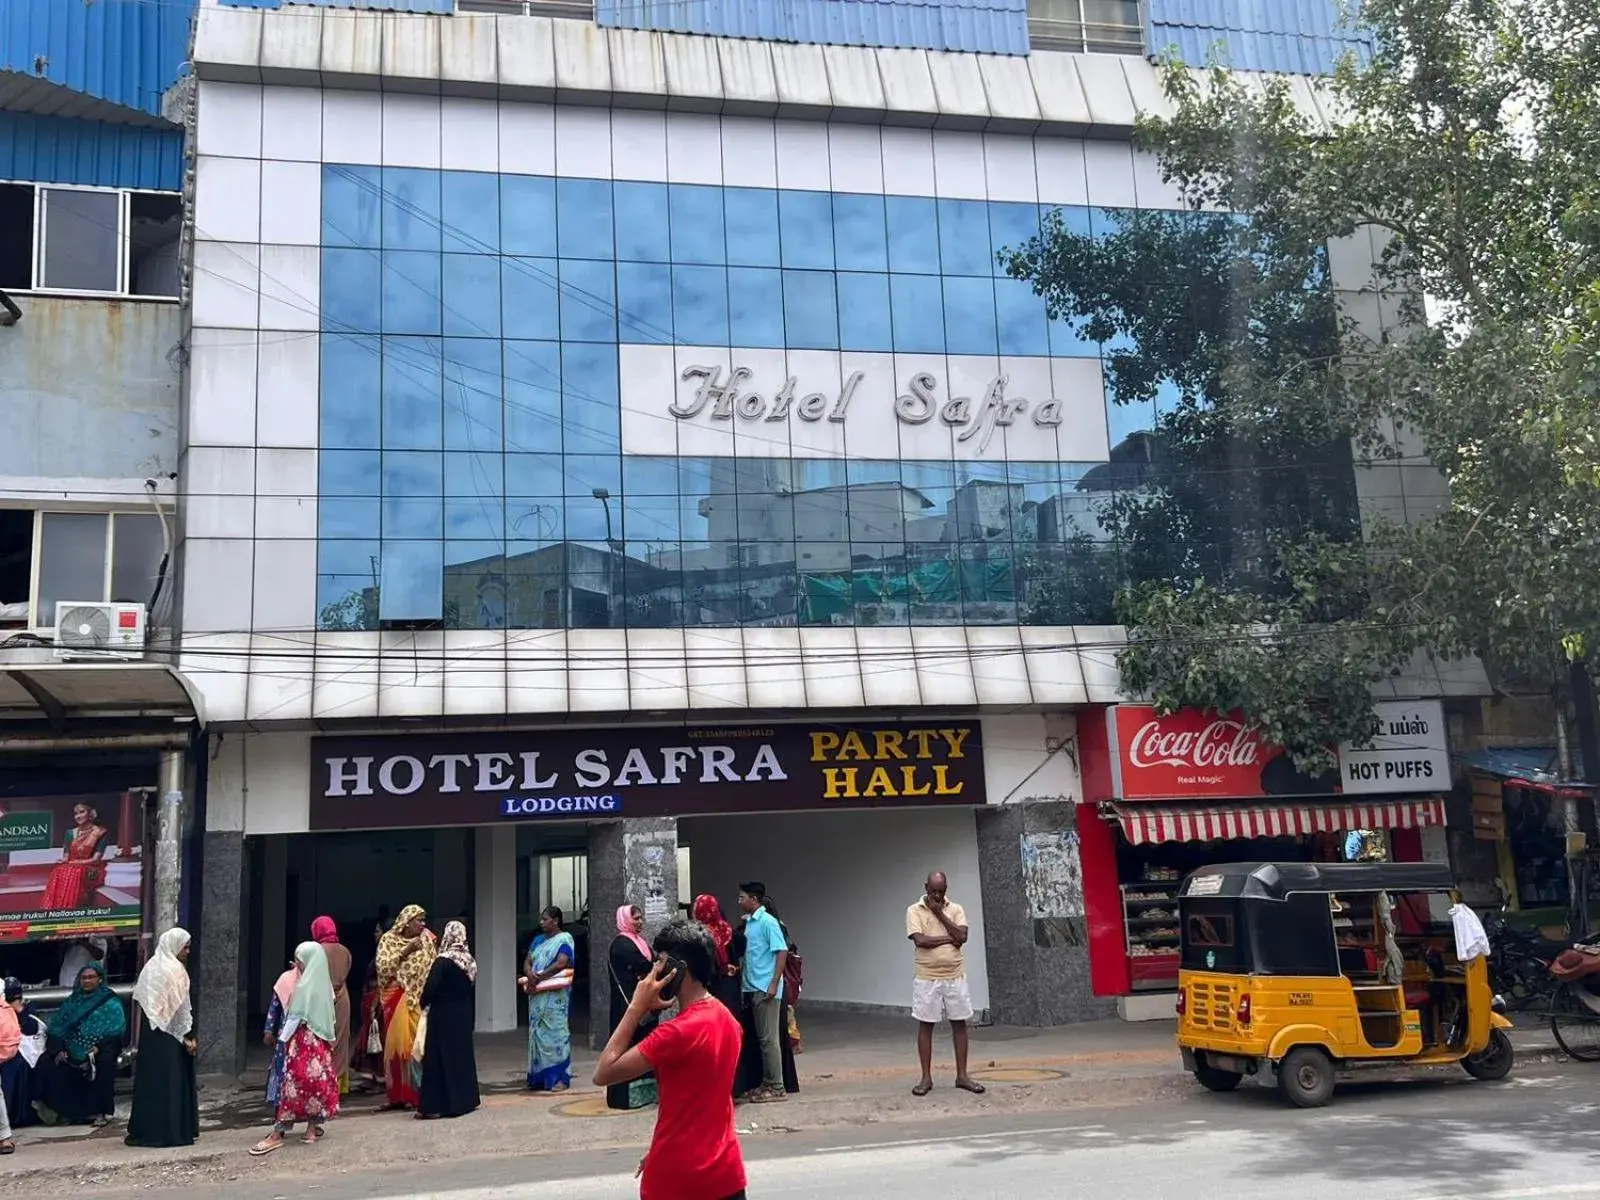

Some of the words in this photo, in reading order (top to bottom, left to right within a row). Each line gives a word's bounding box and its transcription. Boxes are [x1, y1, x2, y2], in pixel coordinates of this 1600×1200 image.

[668, 364, 865, 423] Hotel
[894, 371, 1063, 456] Safra
[808, 728, 970, 761] PARTY
[1129, 720, 1262, 768] Coca-Cola
[324, 751, 559, 797] HOTEL
[574, 743, 789, 788] SAFRA
[822, 764, 963, 798] HALL
[1177, 775, 1196, 784] Real
[1197, 774, 1222, 785] Magic
[1348, 762, 1381, 780] HOT
[1385, 760, 1433, 779] PUFFS
[505, 794, 615, 814] LODGING
